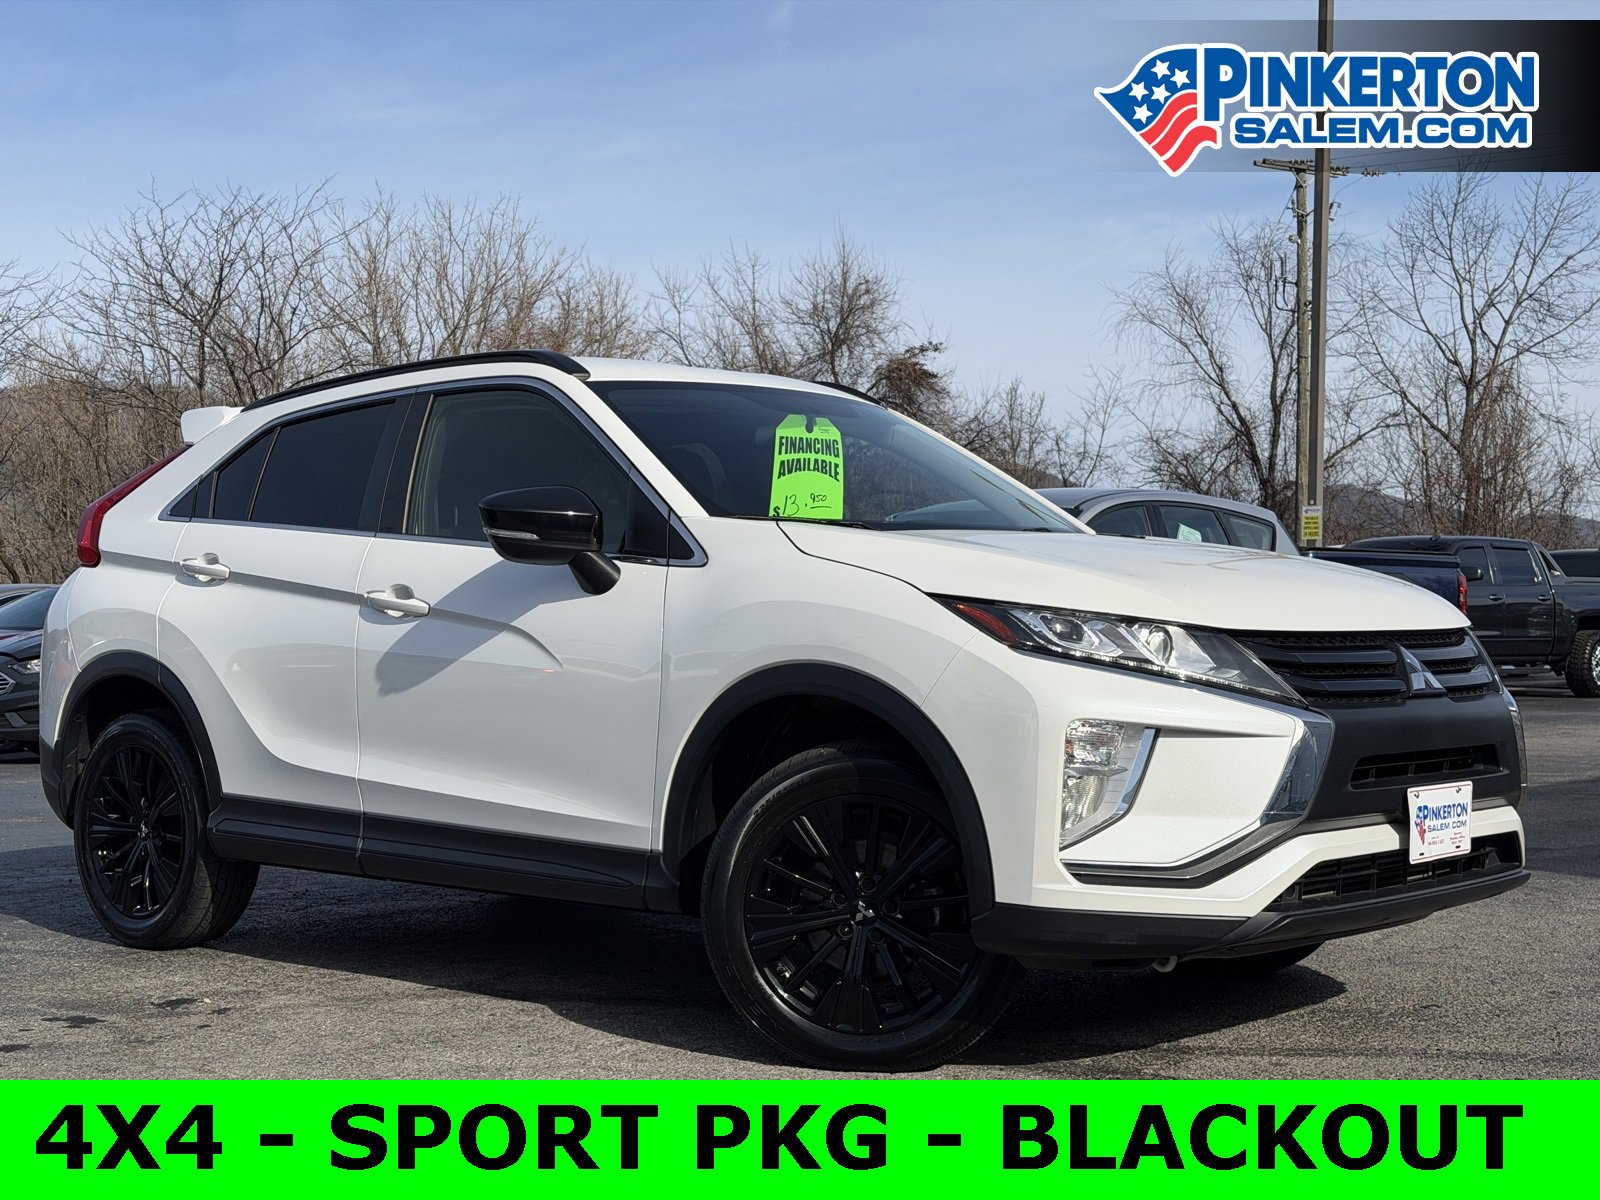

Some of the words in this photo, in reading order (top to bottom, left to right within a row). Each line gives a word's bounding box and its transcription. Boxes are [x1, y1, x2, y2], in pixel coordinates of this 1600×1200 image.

[778, 436, 840, 458] FINANCING
[777, 458, 840, 482] AVAILABLE
[1423, 802, 1468, 826] PINKERTON
[1427, 820, 1467, 832] SALEM.COM
